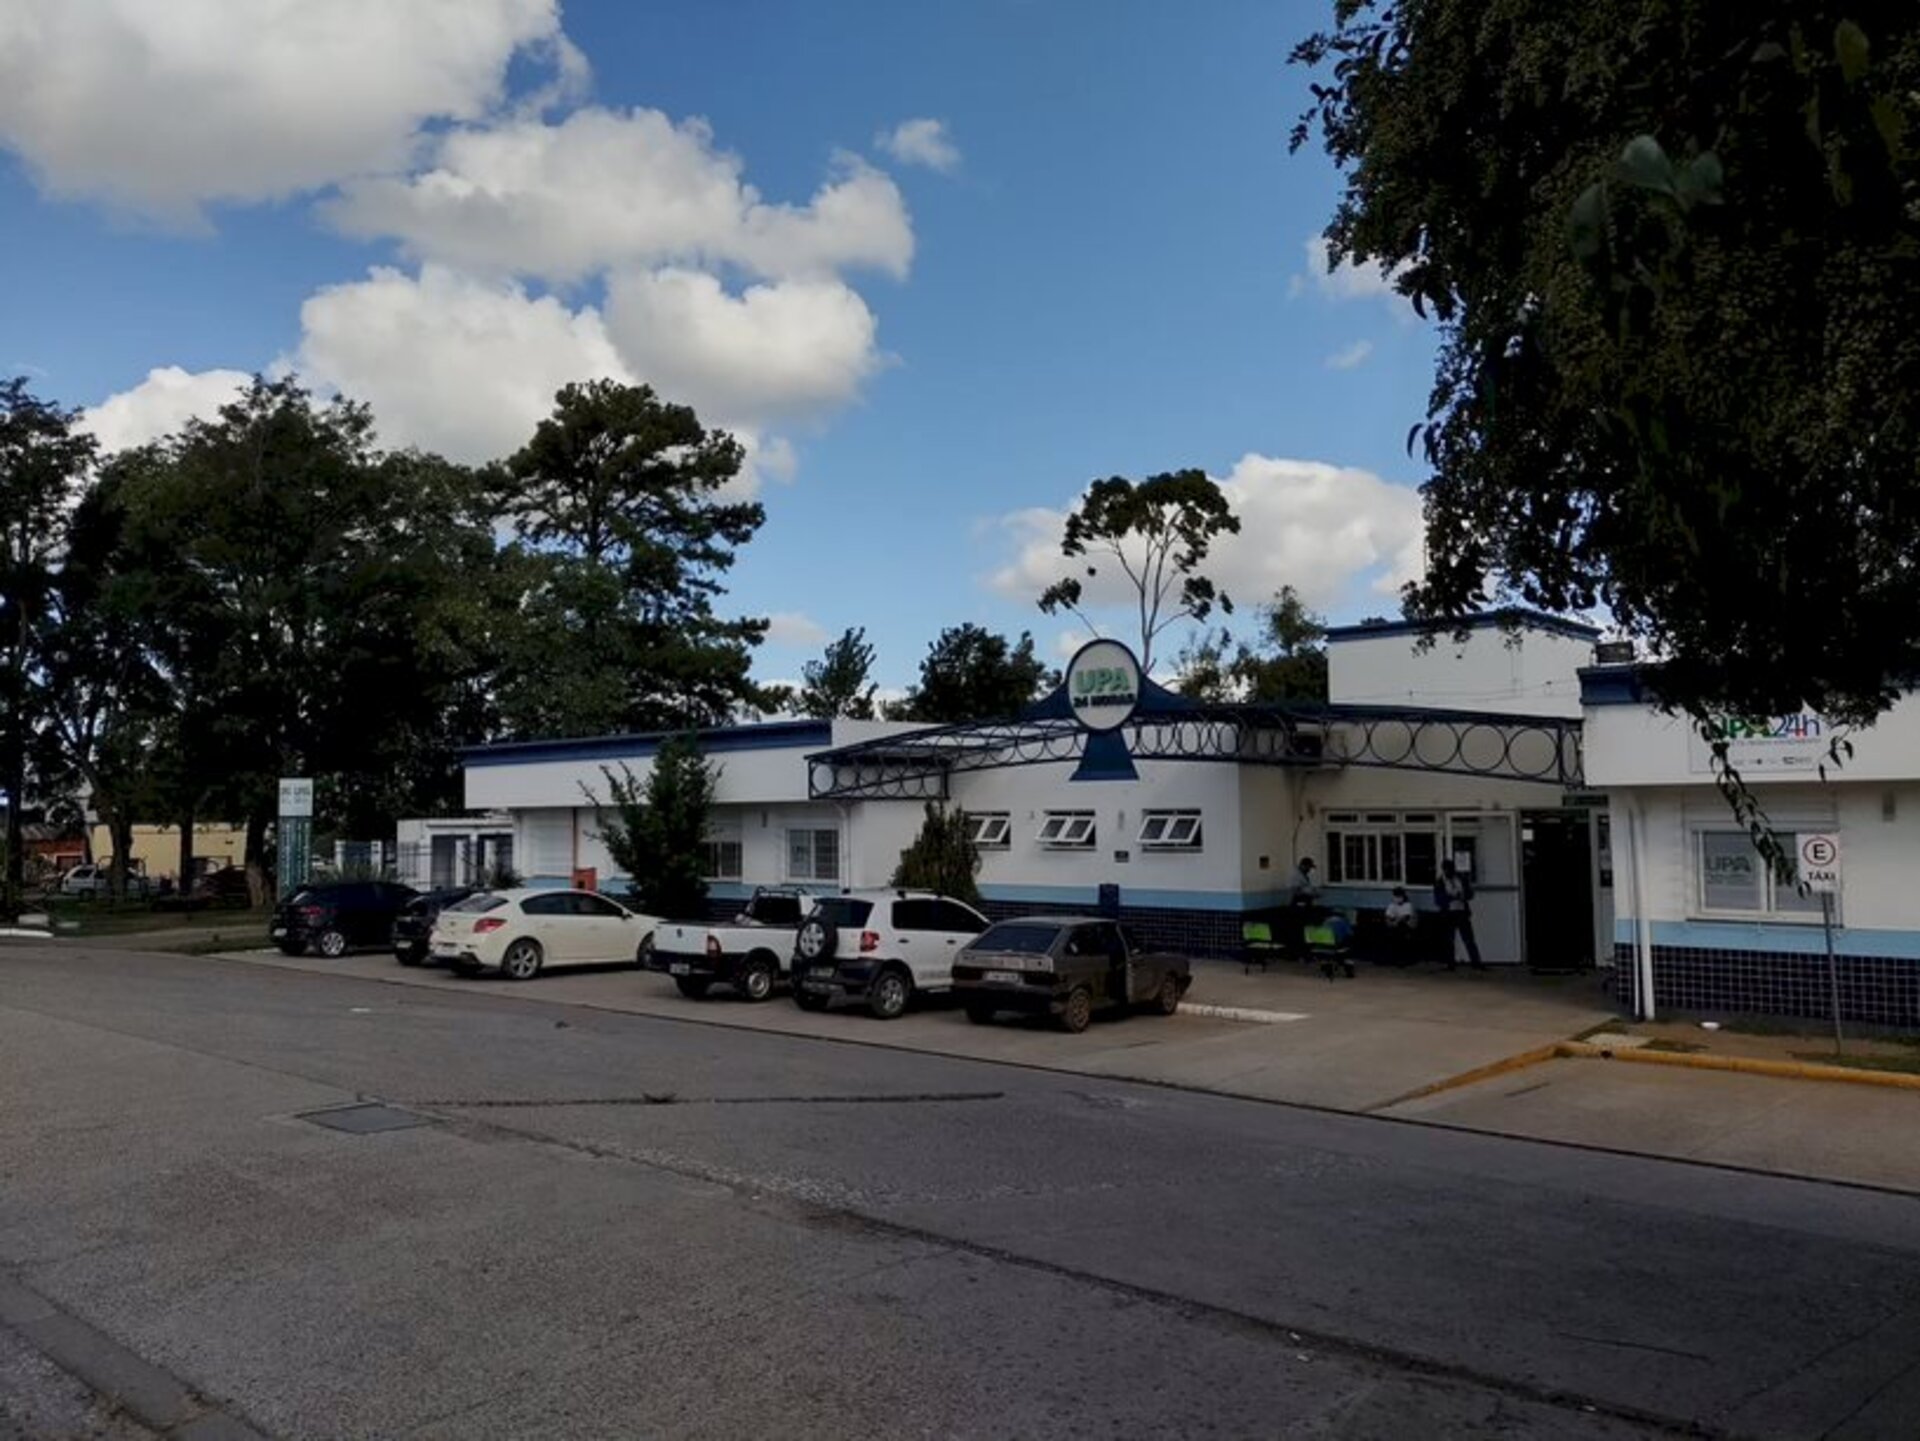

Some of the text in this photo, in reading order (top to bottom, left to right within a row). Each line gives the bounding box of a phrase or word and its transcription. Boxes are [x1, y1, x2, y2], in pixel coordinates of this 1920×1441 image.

[1076, 667, 1130, 693] UPA
[1813, 843, 1826, 860] E
[1706, 856, 1751, 872] UPA
